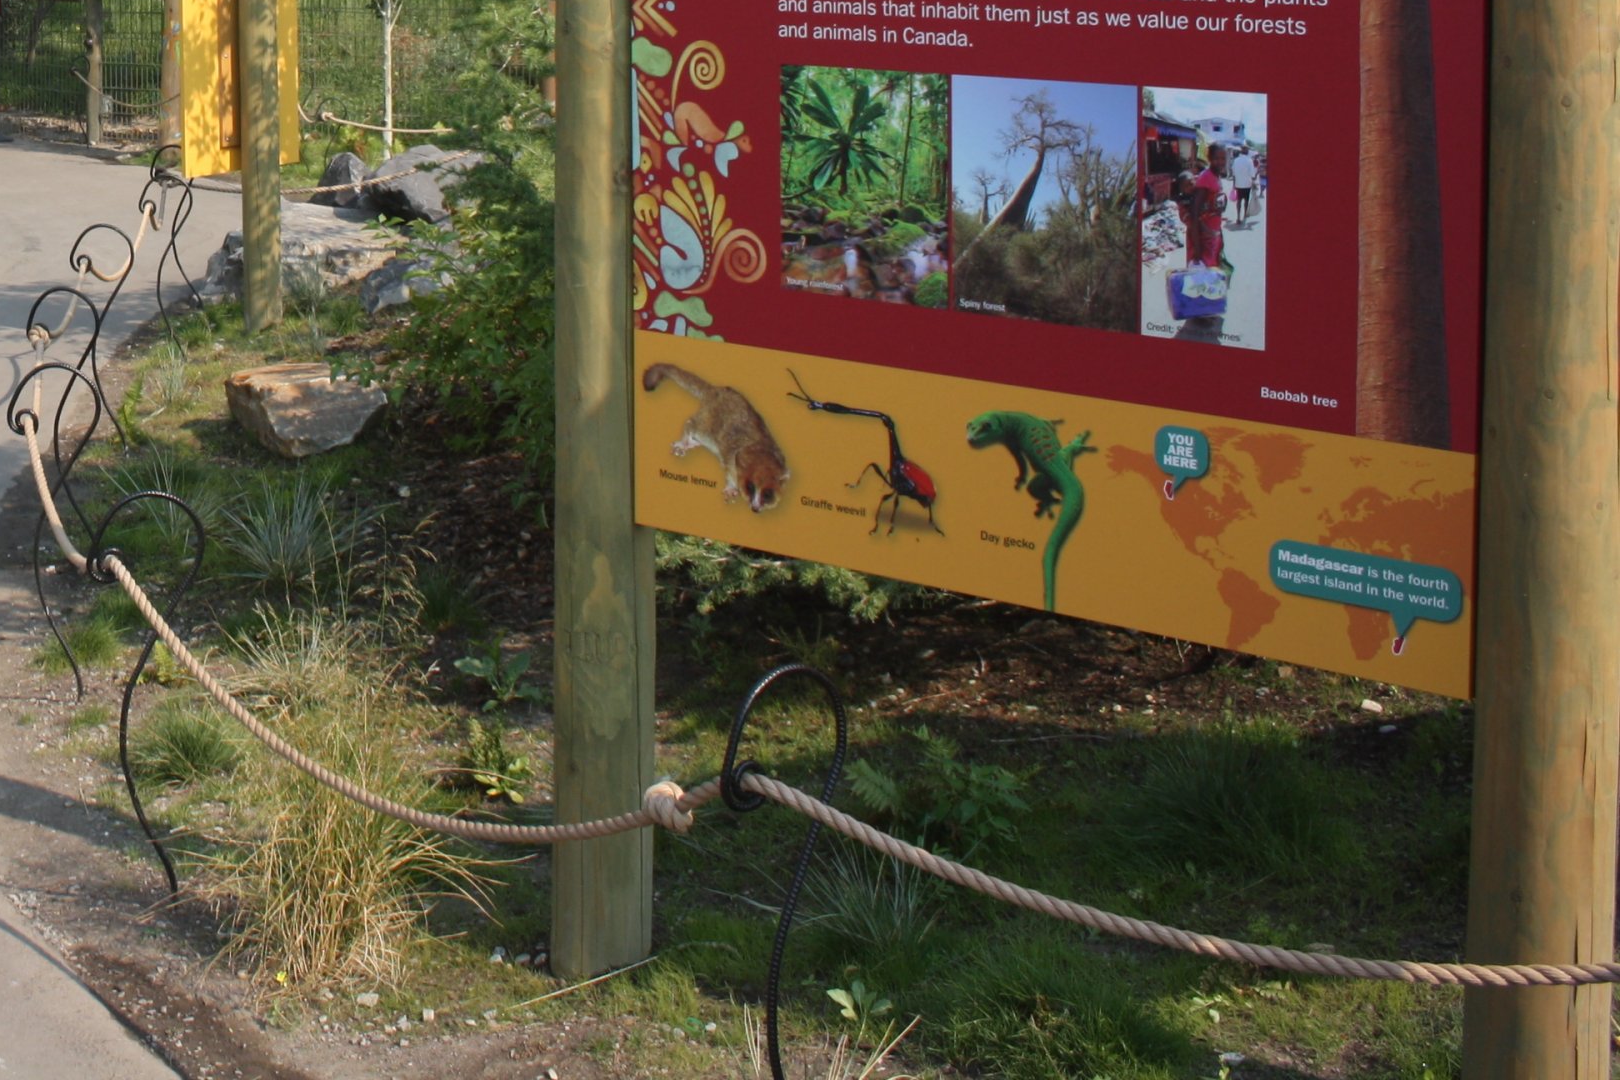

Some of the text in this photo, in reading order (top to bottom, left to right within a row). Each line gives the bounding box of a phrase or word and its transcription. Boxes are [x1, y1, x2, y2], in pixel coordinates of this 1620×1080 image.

[881, 0, 916, 18] that
[921, 1, 980, 21] inhabit
[984, 4, 1031, 23] them
[1034, 5, 1071, 27] just
[1076, 11, 1099, 26] as
[1105, 12, 1131, 28] we
[1137, 10, 1189, 30] value
[1195, 16, 1229, 32] our
[1234, 13, 1307, 36] forests
[778, 22, 973, 47] and animals in Canada.
[959, 297, 1006, 312] Spiny forest
[1146, 321, 1174, 334] Credit:
[1260, 386, 1338, 408] Baobab tree
[1167, 432, 1194, 446] YOU
[1167, 444, 1193, 458] ARE
[1163, 454, 1198, 470] HERE
[659, 468, 717, 488] Mouse lemur
[800, 495, 867, 518] Giraffe weevil
[980, 530, 1036, 551] Day gecko
[1277, 549, 1449, 591] Madagascar is the fourth
[1277, 566, 1450, 610] largest island in the world.
